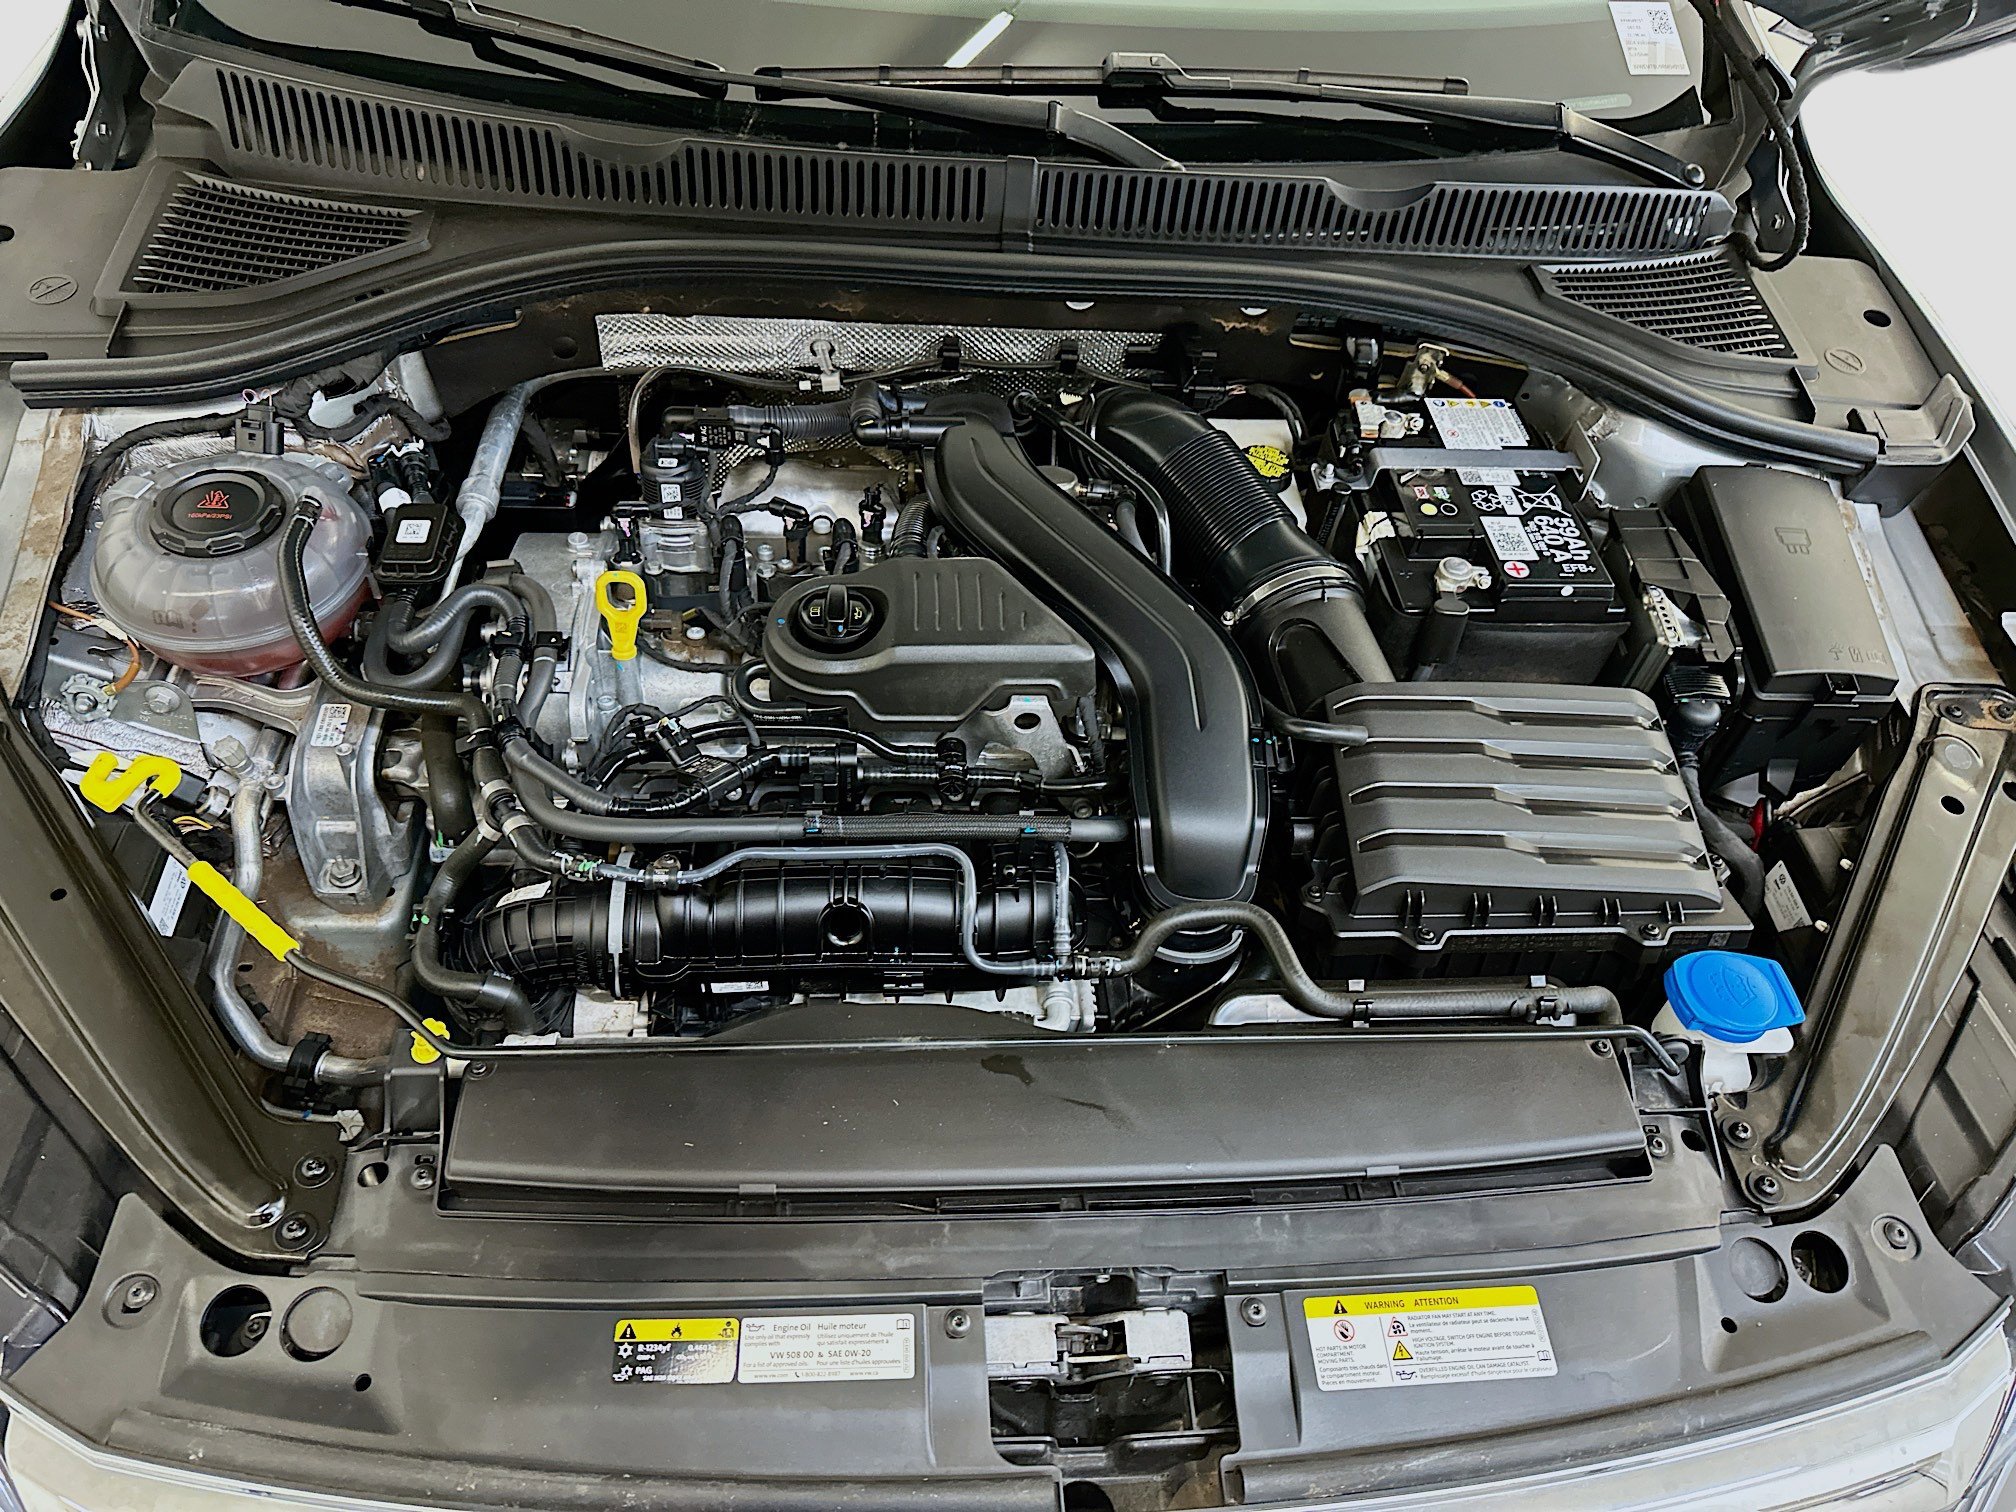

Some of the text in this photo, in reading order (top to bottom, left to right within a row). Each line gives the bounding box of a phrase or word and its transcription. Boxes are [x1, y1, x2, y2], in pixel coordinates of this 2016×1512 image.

[1534, 516, 1565, 546] 640
[1550, 549, 1573, 562] A
[1554, 518, 1591, 561] 59Ah
[1364, 1297, 1459, 1310] WARNING ATTENTION
[774, 1324, 798, 1333] Engine
[638, 1343, 671, 1353] R-1234yf
[635, 1366, 653, 1374] PAG
